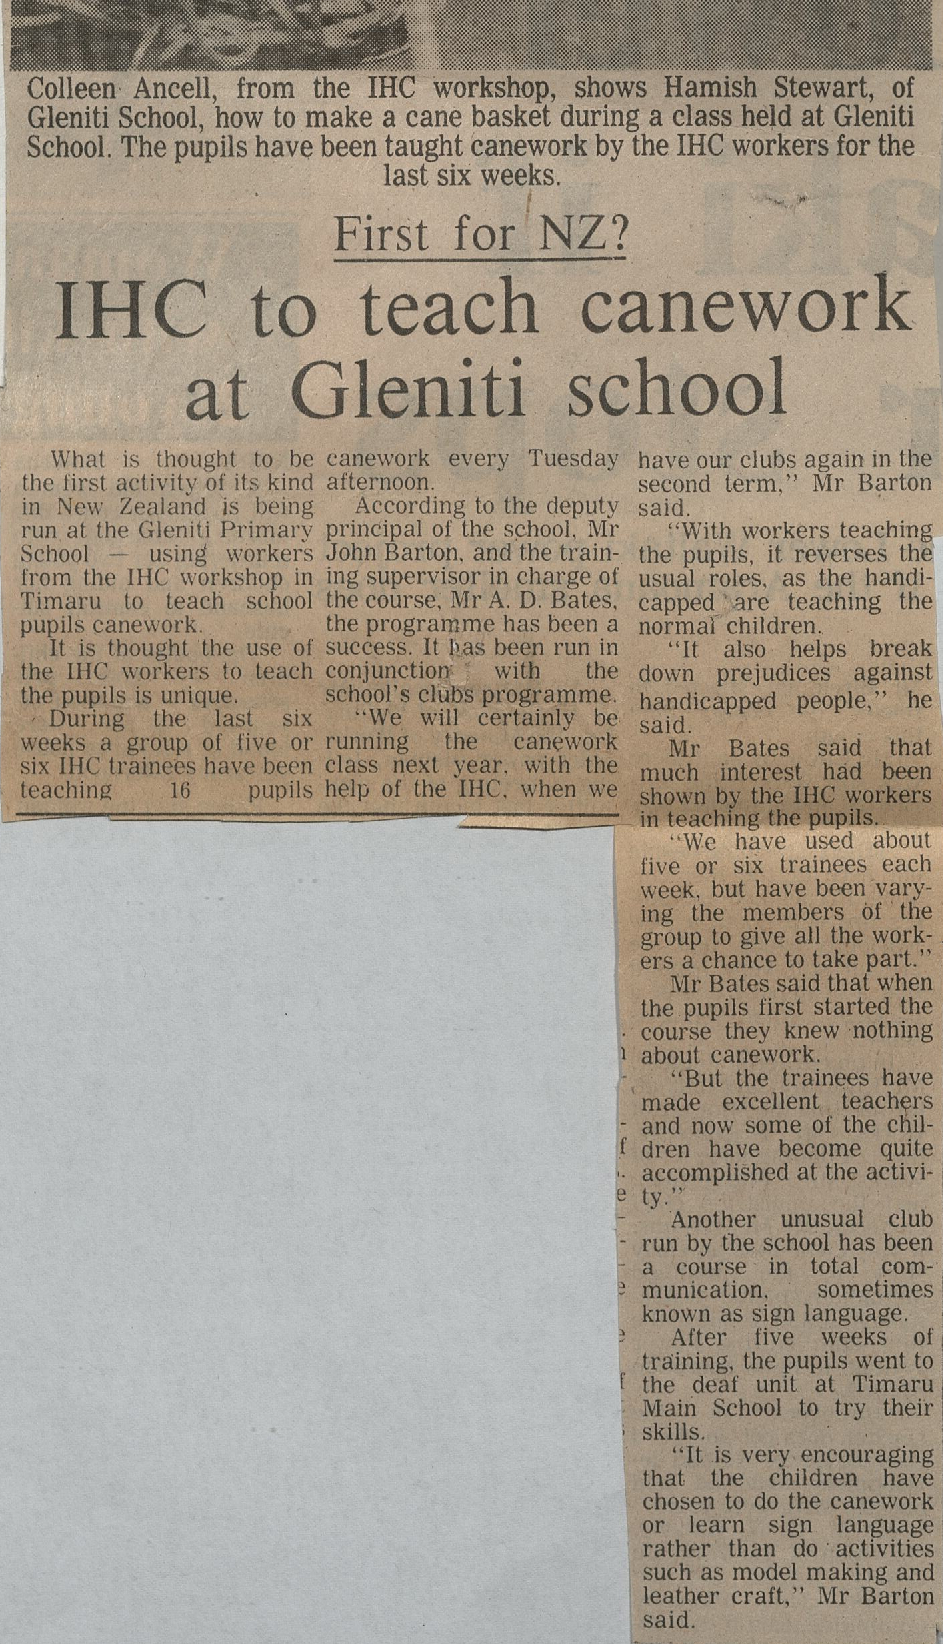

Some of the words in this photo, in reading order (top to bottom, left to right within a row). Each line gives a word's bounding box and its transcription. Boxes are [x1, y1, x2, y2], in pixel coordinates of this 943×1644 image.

[26, 75, 116, 100] Colleen
[132, 75, 218, 105] Ancell,
[236, 76, 296, 100] from
[312, 75, 351, 99] the
[367, 74, 416, 99] IHC
[432, 75, 556, 105] workshop,
[574, 74, 648, 100] shows
[663, 74, 758, 99] Hamish
[774, 75, 874, 104] Stewart,
[892, 75, 916, 99] of
[27, 105, 110, 129] Gleniti
[118, 105, 204, 134] School,
[214, 105, 264, 129] how
[273, 105, 296, 129] to
[305, 104, 373, 129] make
[382, 109, 396, 129] a
[405, 108, 462, 128] cane
[471, 103, 552, 129] basket
[560, 103, 640, 133] during
[648, 108, 664, 127] a
[672, 103, 733, 127] class
[740, 103, 792, 128] held
[800, 105, 825, 128] at
[831, 103, 915, 128] Gleniti
[27, 134, 112, 159] School.
[120, 134, 167, 159] The
[174, 134, 248, 165] pupils
[254, 134, 314, 159] have
[320, 133, 378, 158] been
[384, 133, 464, 163] taught
[470, 133, 588, 157] canework
[594, 133, 624, 163] by
[631, 133, 670, 157] the
[676, 132, 724, 157] IHC
[731, 132, 830, 157] workers
[836, 133, 872, 157] for
[877, 133, 916, 157] the
[383, 162, 429, 187] last
[437, 163, 472, 187] six
[480, 162, 561, 187] weeks.
[333, 214, 428, 253] First
[453, 214, 516, 253] for
[540, 214, 630, 253] NZ?
[54, 277, 206, 340] IHC
[250, 285, 317, 339] to
[359, 274, 540, 337] teach
[581, 269, 914, 335] canework
[184, 368, 250, 422] at
[291, 356, 527, 420] Gleniti
[568, 354, 788, 419] school
[50, 449, 105, 469] What
[123, 449, 140, 469] is
[156, 449, 236, 473] thought
[254, 451, 274, 468] to
[290, 449, 314, 468] be
[326, 448, 430, 467] canework
[448, 453, 510, 472] every
[528, 448, 619, 472] Tuesday
[638, 450, 690, 469] have
[696, 454, 733, 469] our
[740, 449, 797, 469] clubs
[804, 450, 864, 473] again
[872, 449, 891, 468] in
[899, 448, 933, 467] the
[326, 471, 435, 492] afternoon.
[22, 497, 40, 516] in
[57, 497, 104, 516] New
[119, 496, 206, 517] Zealand
[222, 497, 240, 516] is
[255, 496, 314, 520] being
[354, 495, 466, 520] According
[475, 496, 495, 515] to
[504, 495, 538, 515] the
[546, 495, 620, 520] deputy
[21, 568, 72, 587] from
[83, 568, 116, 587] the
[126, 566, 169, 587] IHC
[180, 567, 283, 591] workshop
[294, 567, 313, 586] in
[326, 566, 359, 590] ing
[366, 566, 482, 590] supervisor
[488, 566, 509, 585] in
[516, 566, 591, 590] charge
[598, 566, 620, 586] of
[326, 589, 359, 609] the
[365, 592, 442, 611] course,
[450, 590, 482, 609] Mr
[488, 590, 510, 609] A.
[519, 590, 542, 609] D.
[550, 590, 618, 611] Bates,
[20, 614, 85, 639] pupils
[92, 614, 203, 634] canework.
[20, 732, 86, 752] weeks
[100, 736, 112, 752] a
[126, 736, 188, 757] group
[202, 732, 223, 752] of
[236, 732, 277, 752] five
[290, 736, 314, 752] or
[640, 762, 699, 782] much
[720, 762, 803, 782] interest
[822, 761, 862, 781] had
[882, 760, 932, 781] been
[20, 780, 113, 801] teaching
[170, 780, 191, 800] 16
[248, 779, 314, 804] pupils
[324, 778, 370, 802] help
[381, 778, 402, 798] of
[414, 778, 447, 798] the
[458, 778, 508, 800] IHC,
[520, 778, 576, 798] when
[588, 783, 618, 798] we
[639, 786, 706, 806] shown
[715, 786, 742, 810] by
[750, 786, 784, 805] the
[792, 785, 836, 805] IHC
[845, 785, 932, 805] workers
[640, 857, 680, 876] five
[695, 860, 718, 876] or
[733, 855, 764, 874] six
[780, 854, 867, 874] trainees
[882, 853, 932, 873] each
[641, 1140, 690, 1159] dren
[708, 1139, 760, 1158] have
[778, 1138, 862, 1158] become
[880, 1138, 934, 1162] quite
[671, 1209, 757, 1229] Another
[780, 1208, 865, 1228] unusual
[888, 1208, 934, 1228] club
[670, 1327, 728, 1347] After
[754, 1327, 794, 1346] five
[821, 1326, 888, 1346] weeks
[913, 1327, 934, 1346] of
[642, 1398, 697, 1418] Main
[713, 1397, 782, 1417] School
[798, 1398, 819, 1417] to
[834, 1398, 866, 1421] try
[882, 1397, 935, 1417] their
[642, 1491, 716, 1511] chosen
[724, 1491, 745, 1511] to
[754, 1491, 779, 1511] do
[788, 1491, 822, 1511] the
[830, 1491, 935, 1511] canework
[643, 1562, 692, 1581] such
[700, 1566, 724, 1581] as
[732, 1562, 798, 1581] model
[806, 1561, 888, 1587] making
[896, 1562, 936, 1582] and
